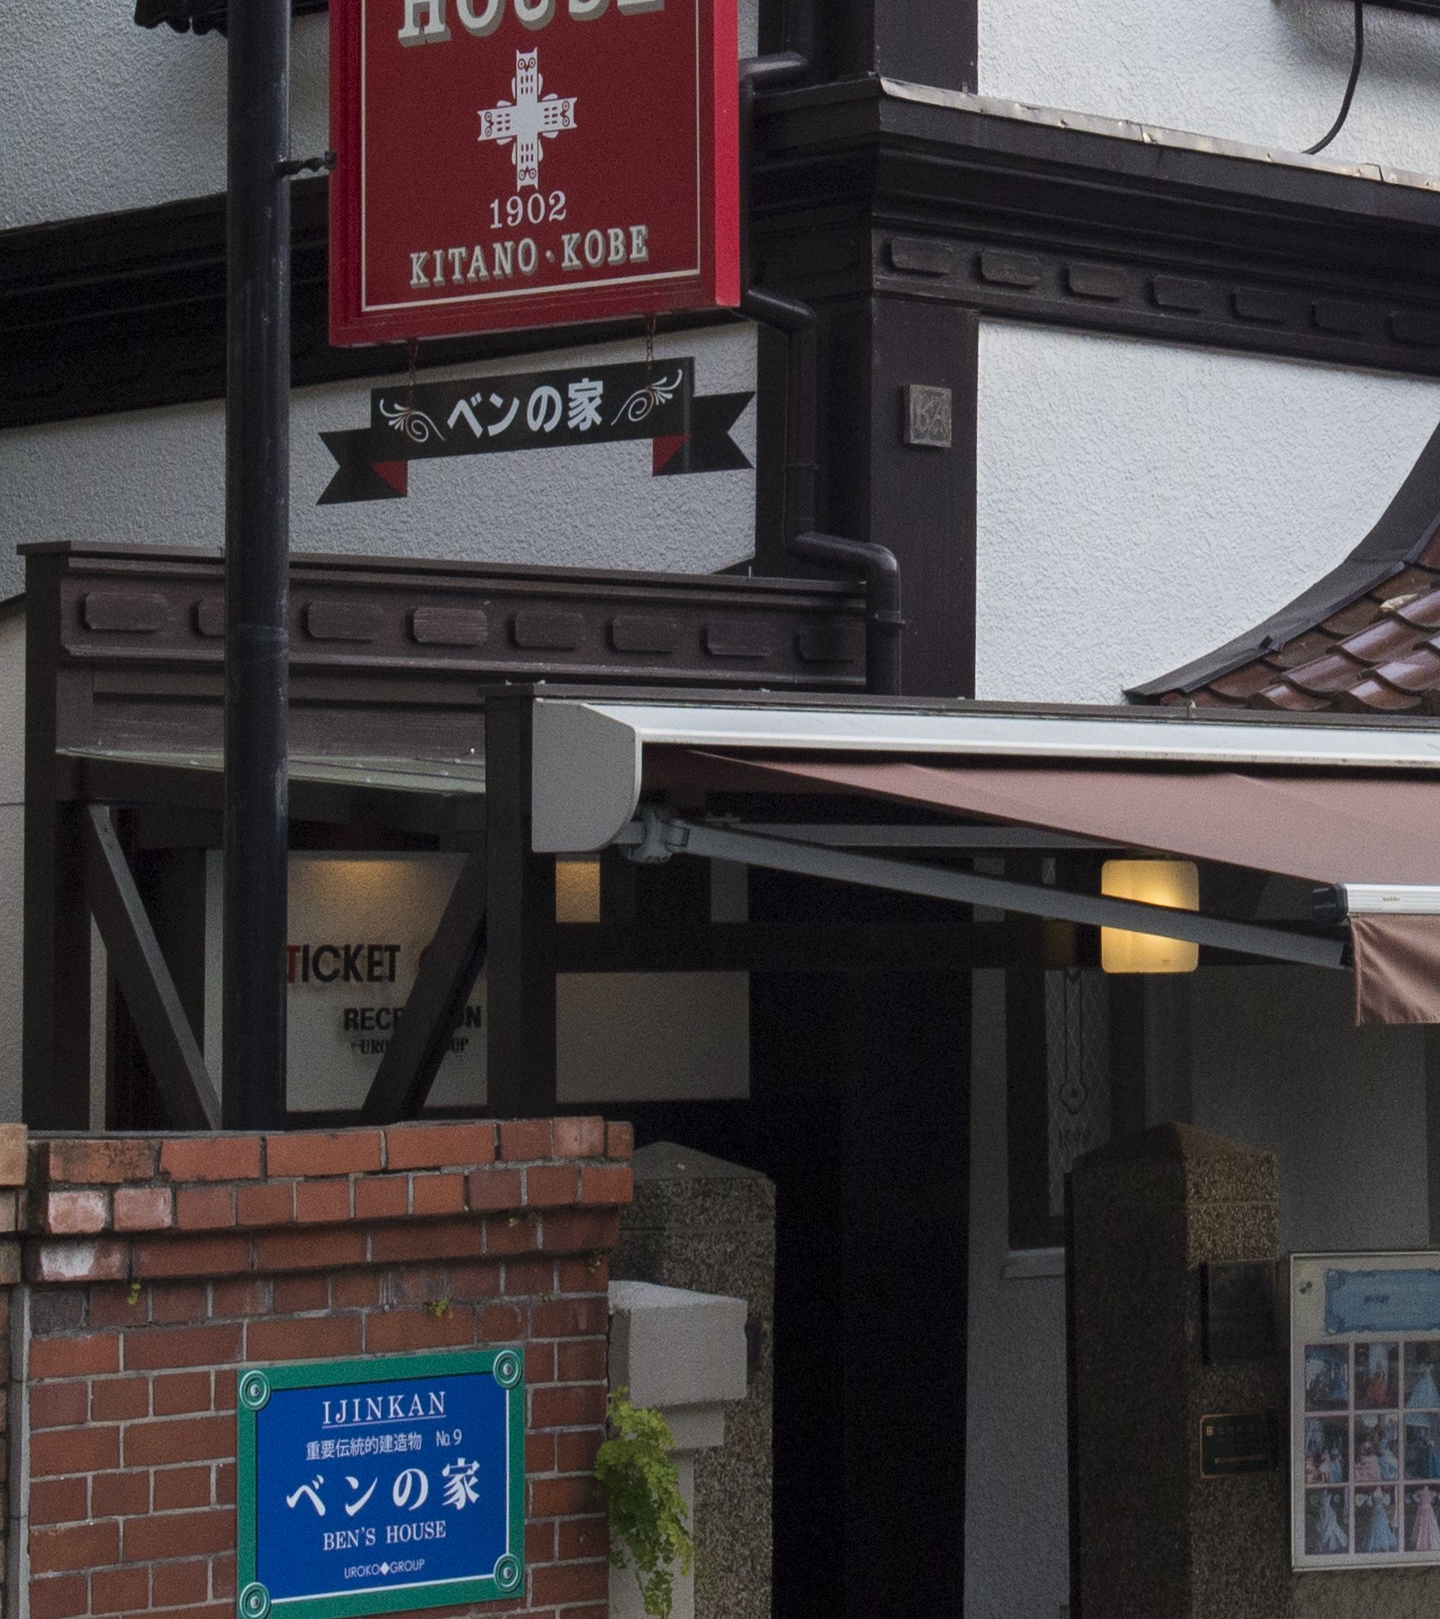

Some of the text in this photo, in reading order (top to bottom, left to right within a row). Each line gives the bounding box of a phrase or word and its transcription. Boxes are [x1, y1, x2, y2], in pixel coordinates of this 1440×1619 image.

[490, 191, 568, 228] 1902
[446, 380, 605, 438] ベンの家
[287, 944, 400, 983] TICKET
[323, 1392, 446, 1424] IJINKAN
[306, 1432, 422, 1461] 重要伝統的建造物
[286, 1457, 481, 1517] ベンの家
[323, 1520, 446, 1551] BEN'S HOUSE
